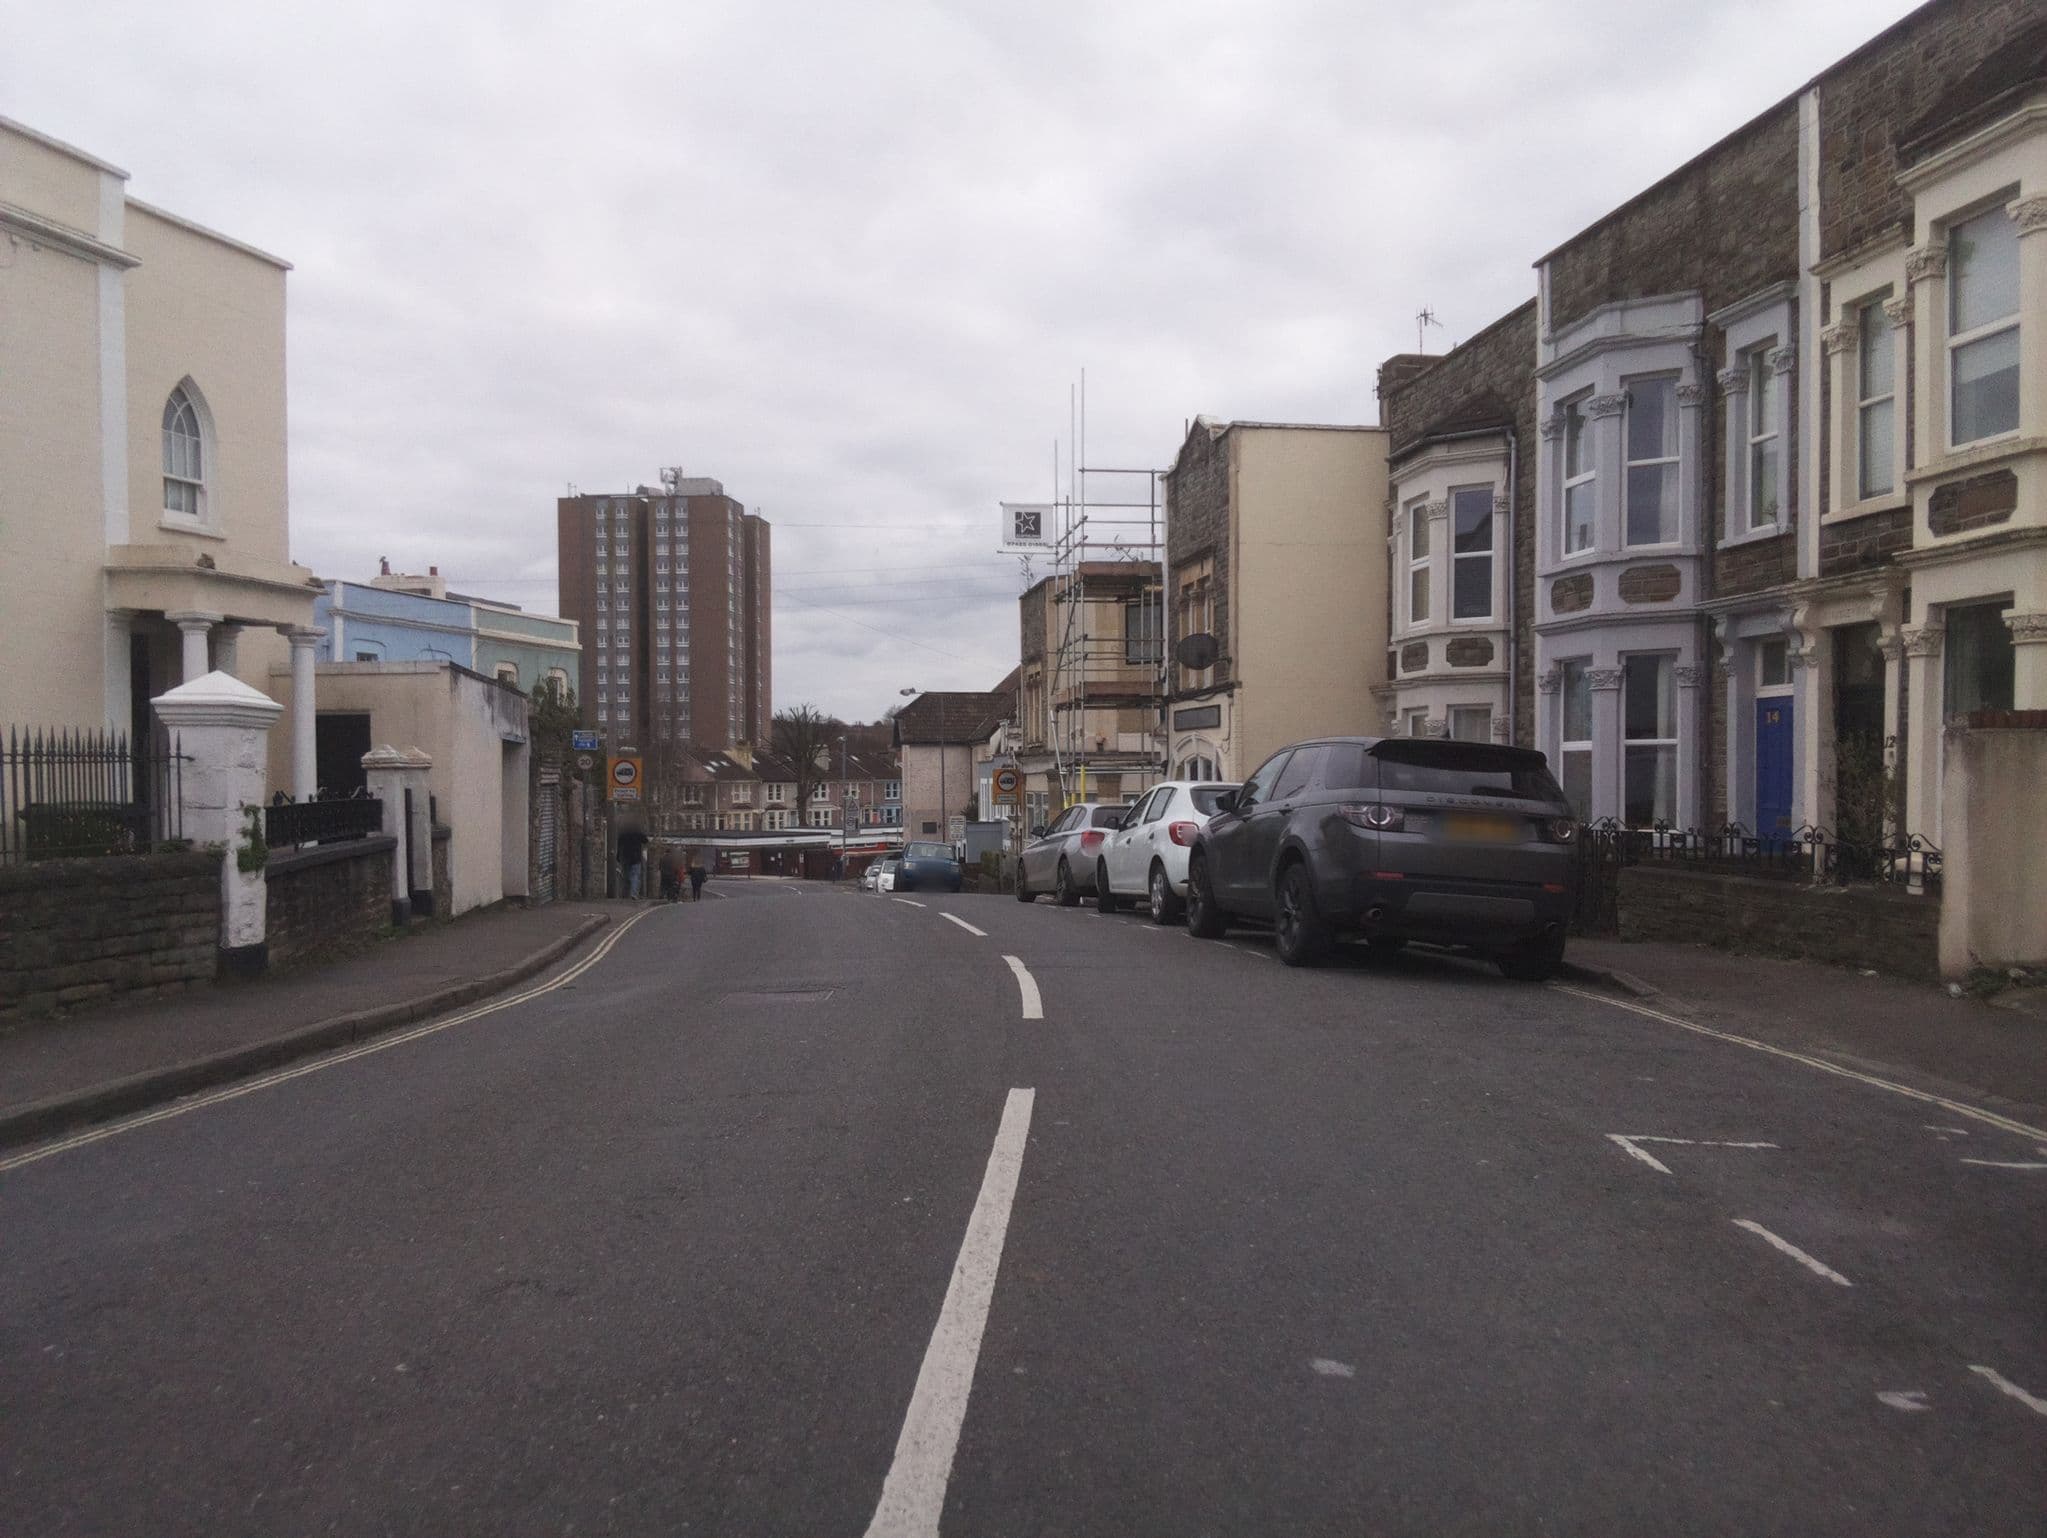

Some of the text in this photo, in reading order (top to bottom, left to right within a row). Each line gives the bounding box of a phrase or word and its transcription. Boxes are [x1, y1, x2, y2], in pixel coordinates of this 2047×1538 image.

[1766, 711, 1779, 723] 14
[1885, 735, 1897, 748] 12
[580, 758, 591, 766] 20
[1426, 796, 1527, 809] DISCOVERY
